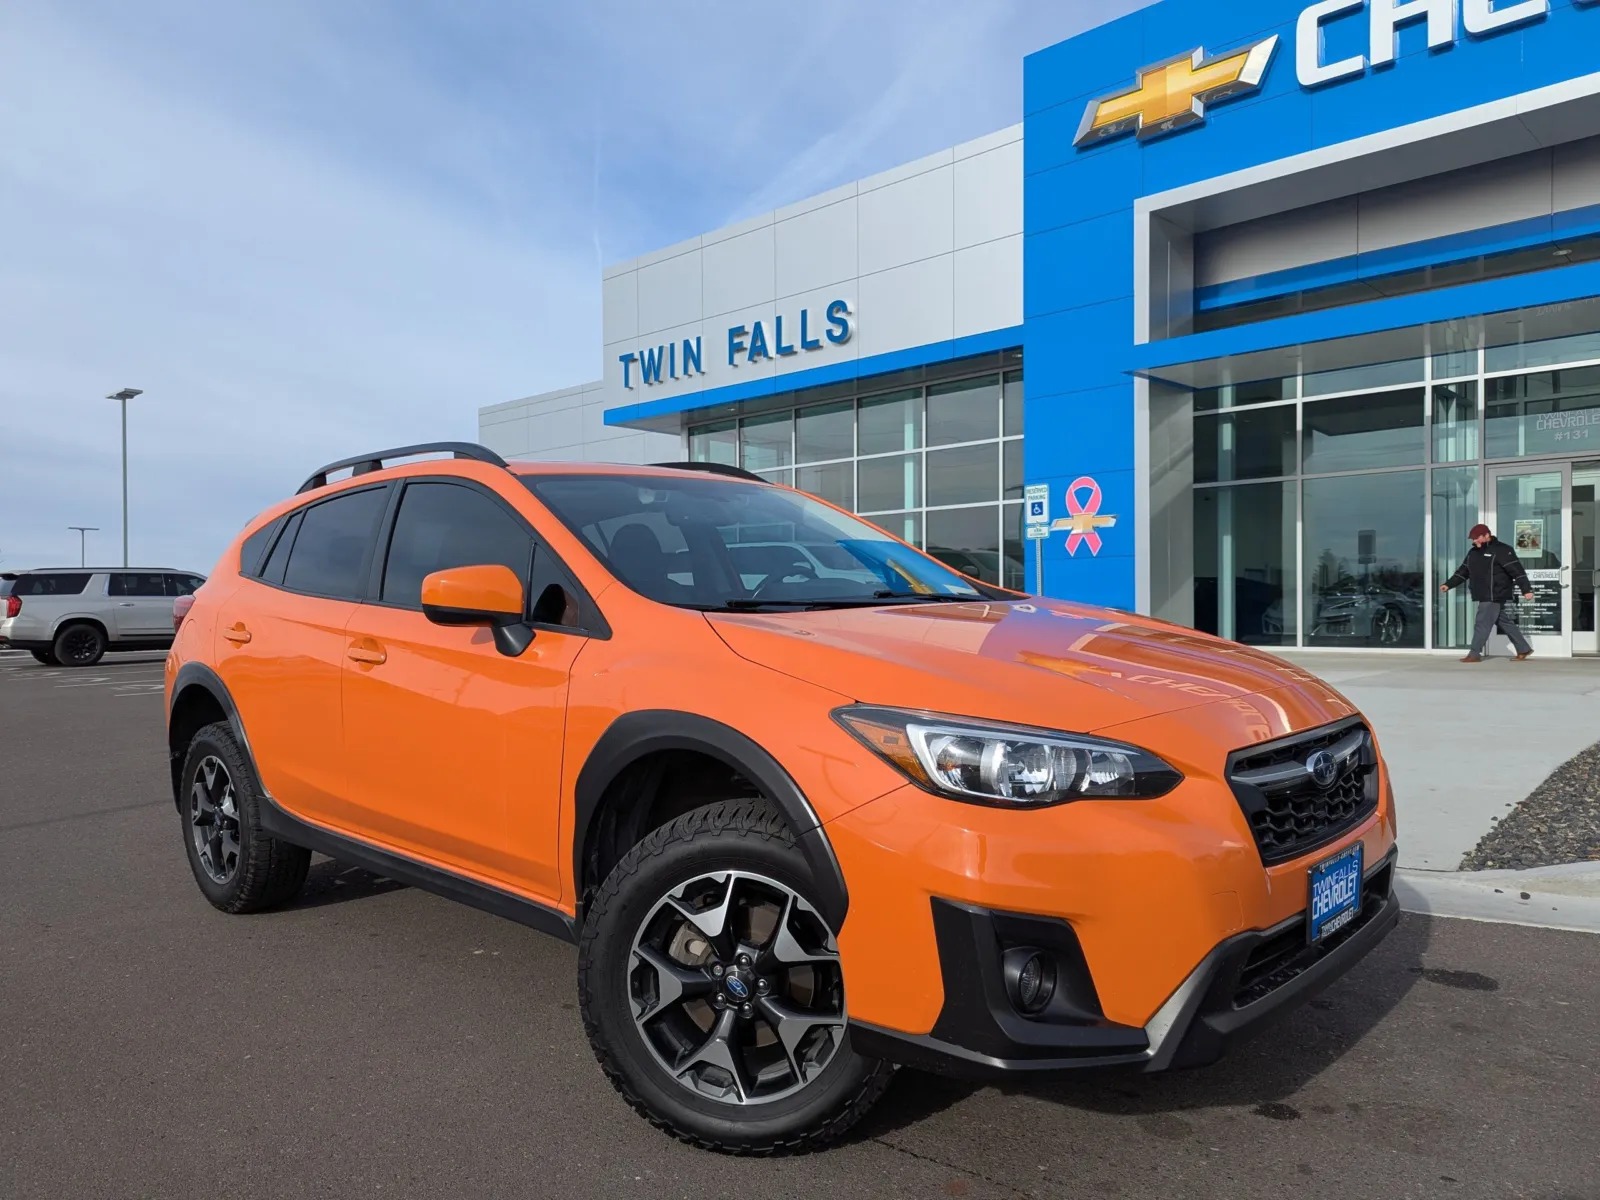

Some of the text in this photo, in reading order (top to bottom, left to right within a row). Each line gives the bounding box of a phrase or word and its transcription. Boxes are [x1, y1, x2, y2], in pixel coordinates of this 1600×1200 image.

[618, 299, 851, 389] TWIN FALLS
[1554, 429, 1589, 441] #131
[1312, 872, 1358, 920] CHEVROLET
